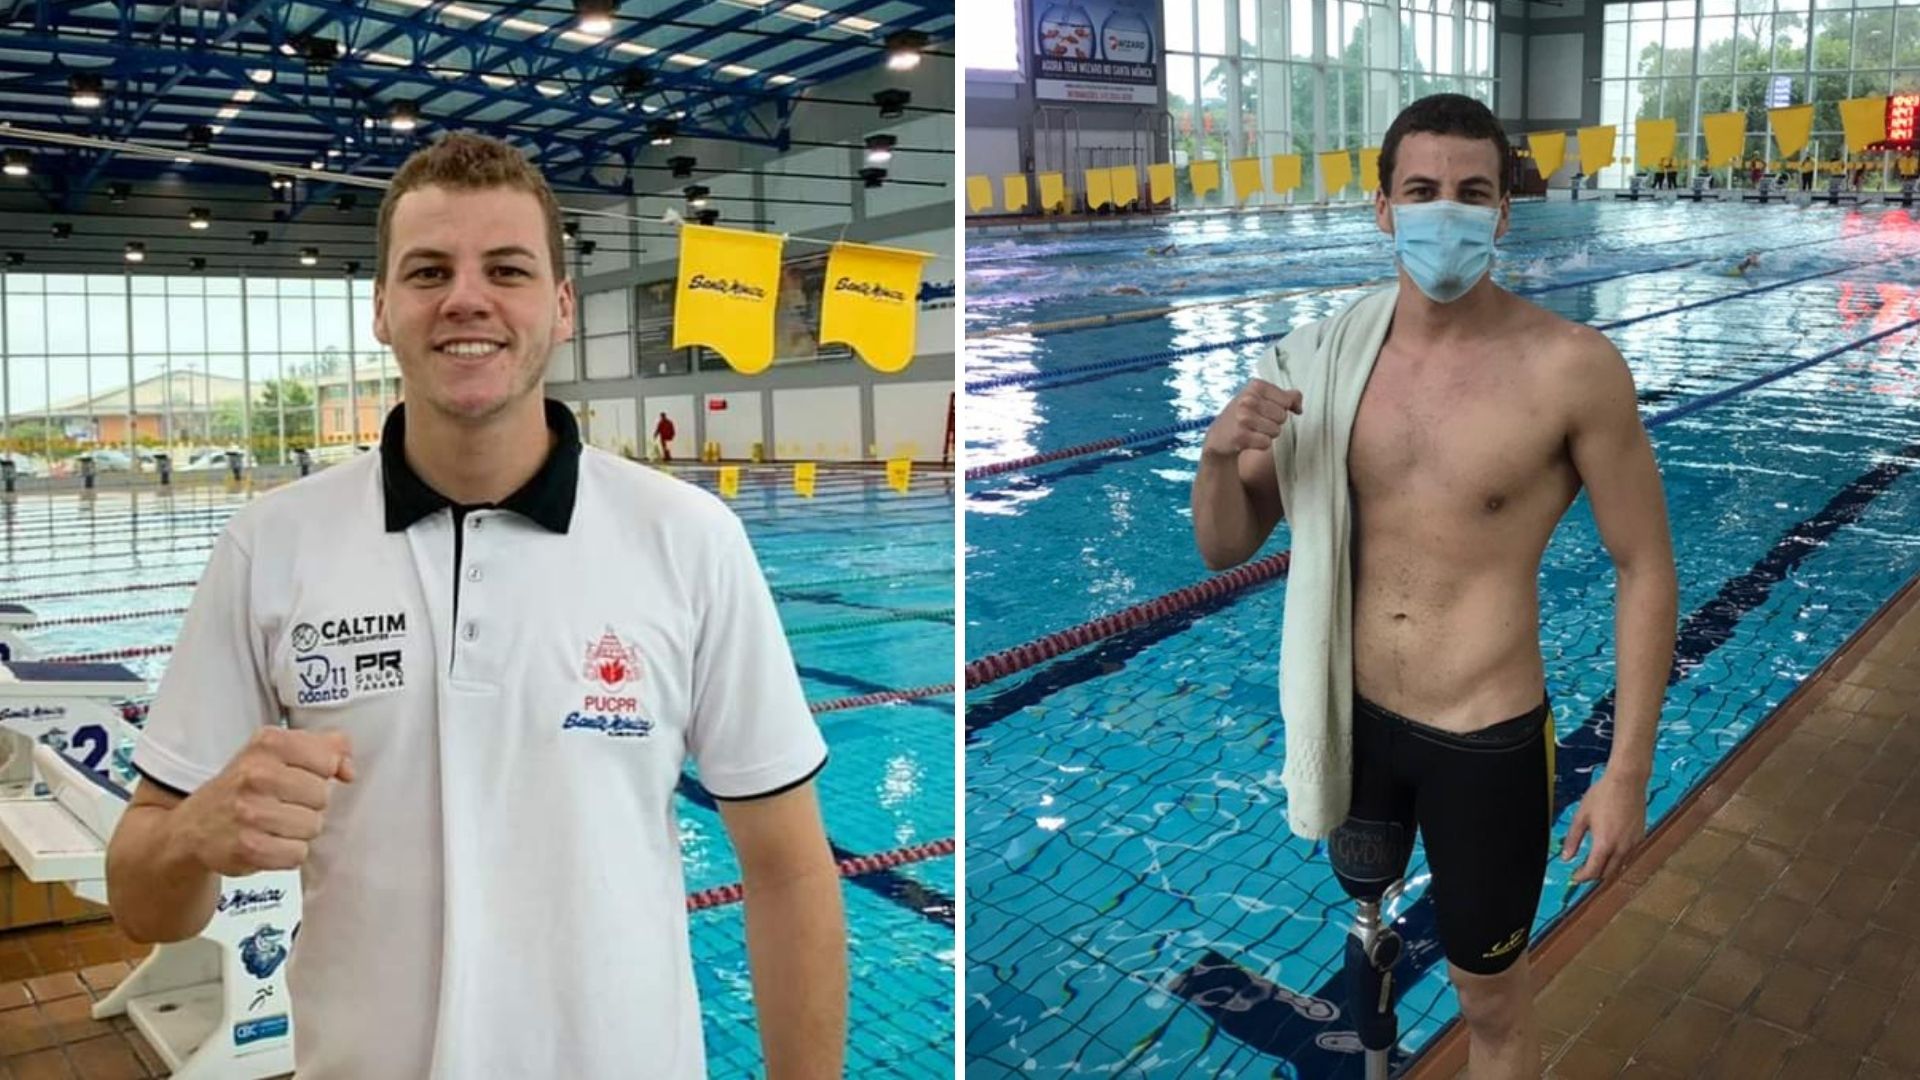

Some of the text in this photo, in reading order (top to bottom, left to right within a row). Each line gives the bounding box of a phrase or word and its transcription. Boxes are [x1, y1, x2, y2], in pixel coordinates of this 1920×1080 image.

[321, 612, 406, 640] CALTIM
[355, 650, 402, 672] PR
[298, 687, 349, 704] Odonto
[584, 696, 636, 712] PUCPR
[73, 724, 109, 778] 2
